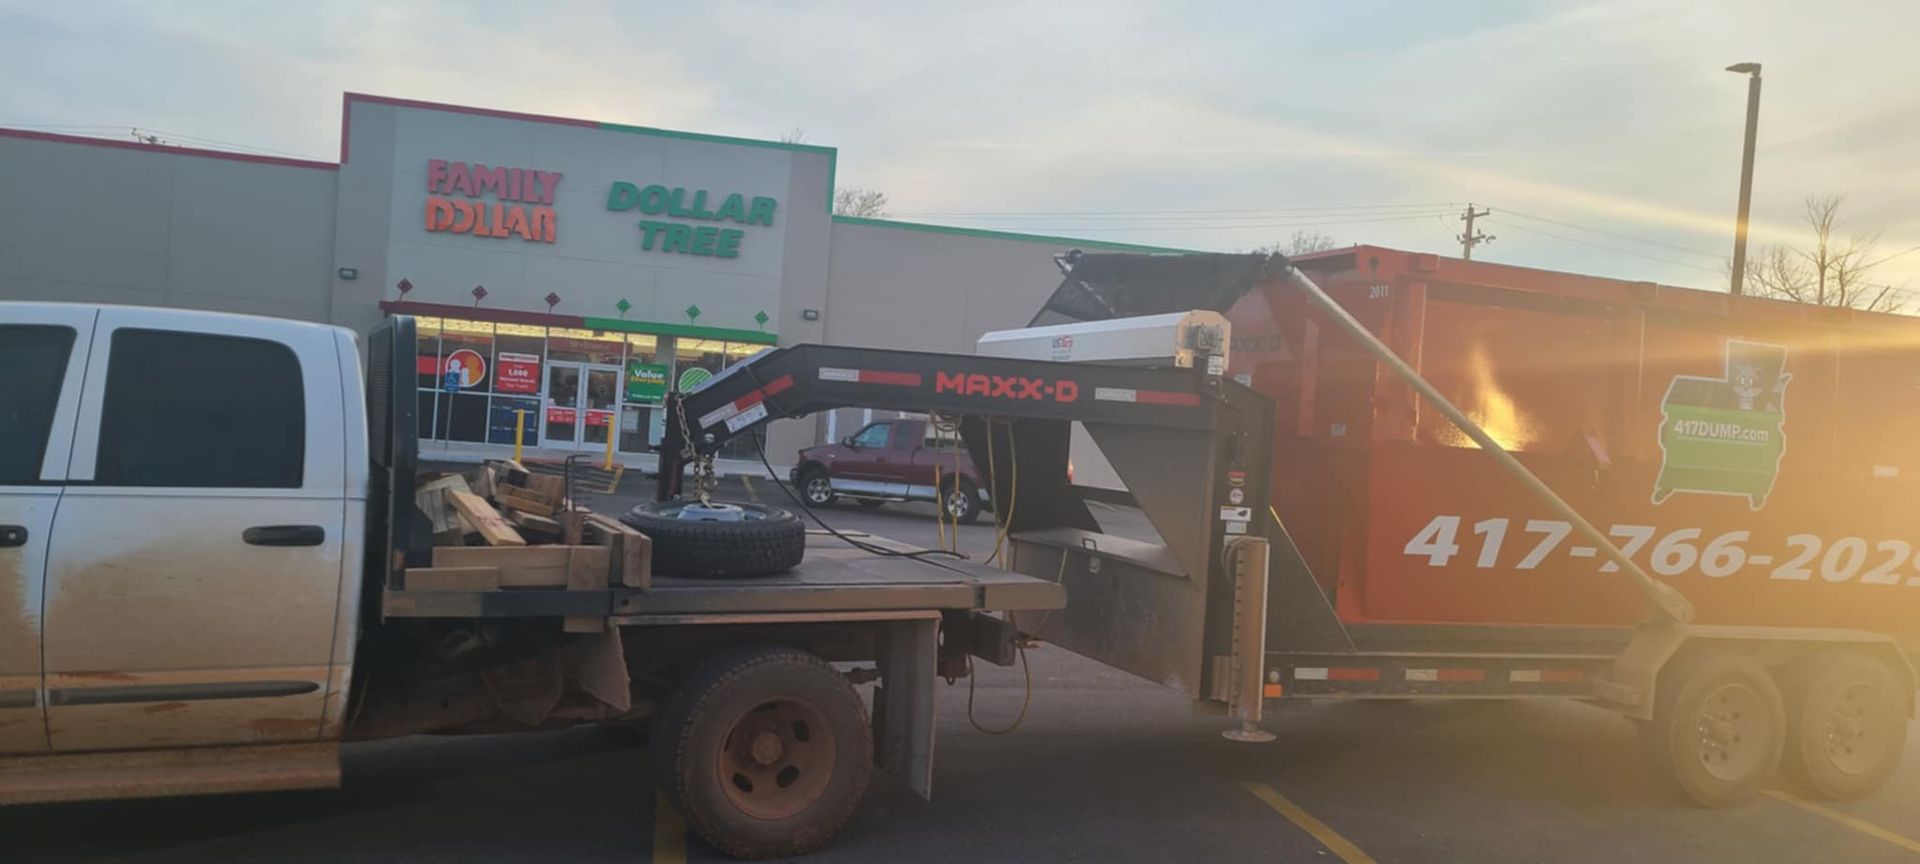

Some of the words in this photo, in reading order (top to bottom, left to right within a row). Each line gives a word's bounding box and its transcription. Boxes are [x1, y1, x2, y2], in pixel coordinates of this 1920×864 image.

[427, 158, 562, 205] FAMILY
[424, 197, 557, 243] DOLLAR
[606, 180, 777, 226] DOLLAR
[639, 219, 745, 258] TREE
[1368, 284, 1389, 299] 2011
[633, 368, 665, 379] Value
[935, 371, 1079, 403] MAXX-D
[1674, 419, 1769, 442] 417DUMP.com
